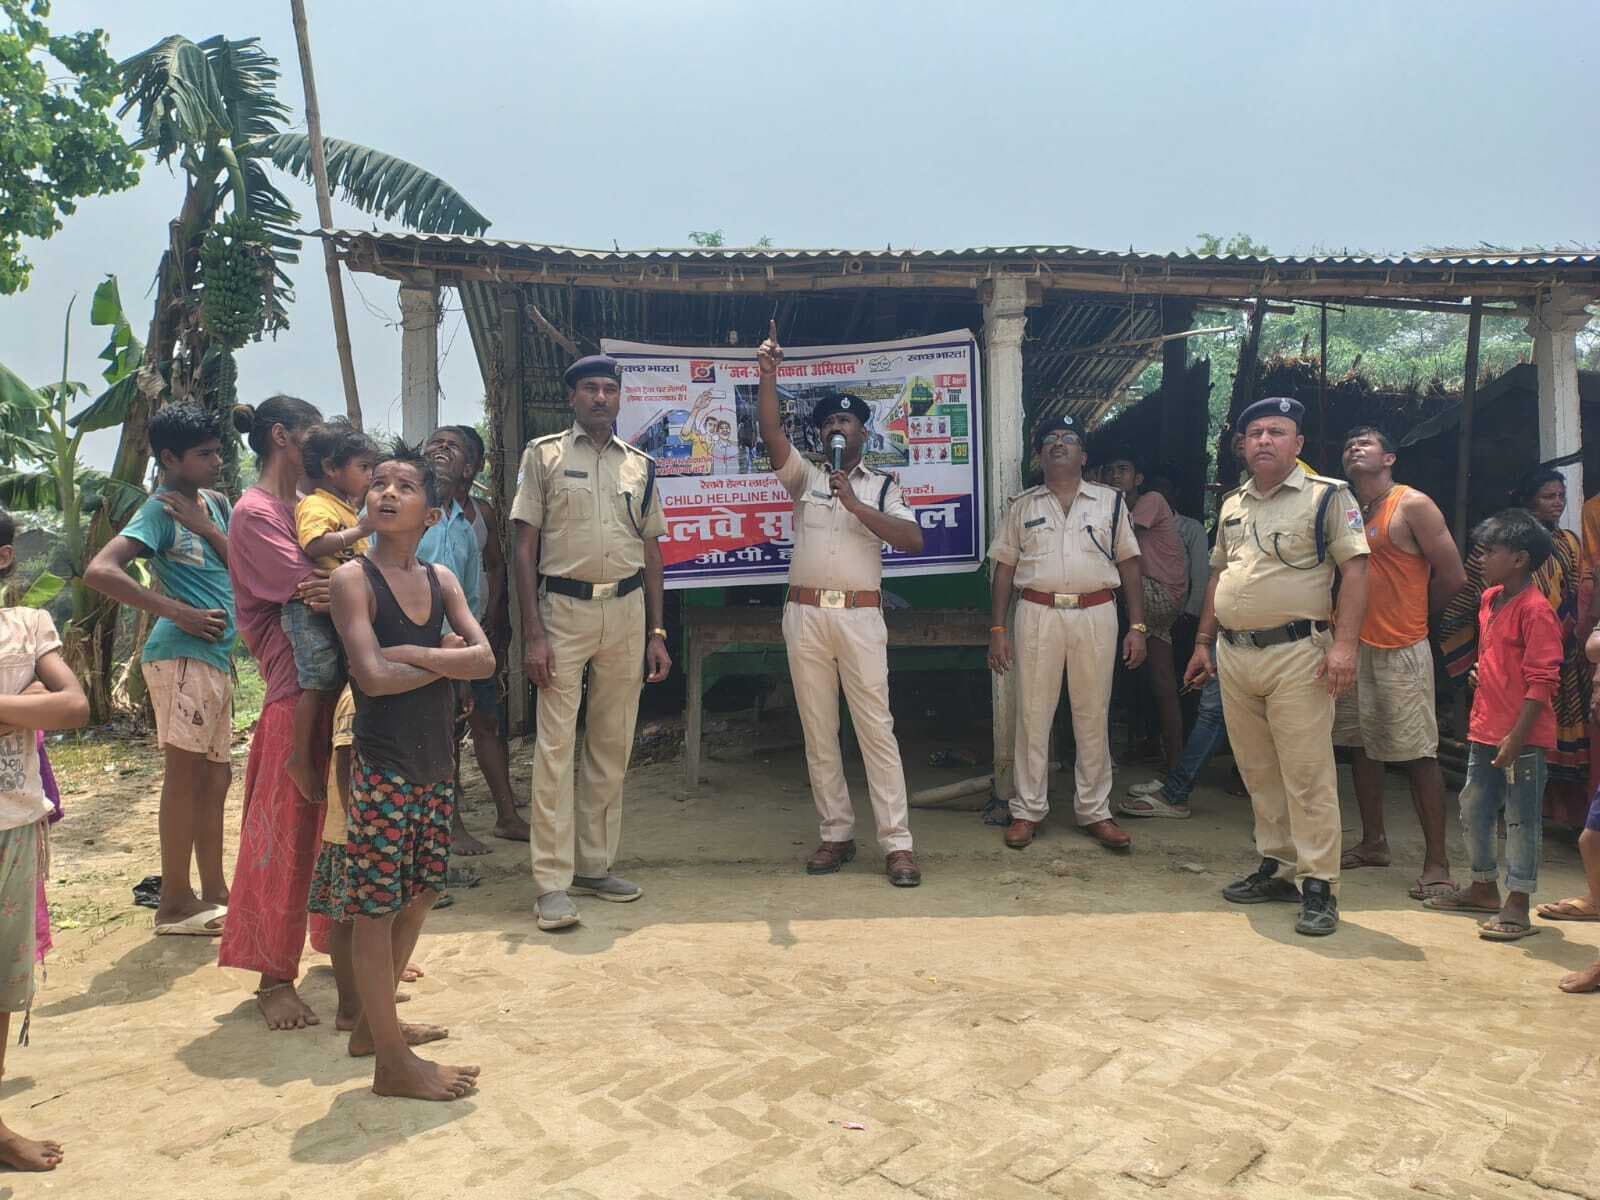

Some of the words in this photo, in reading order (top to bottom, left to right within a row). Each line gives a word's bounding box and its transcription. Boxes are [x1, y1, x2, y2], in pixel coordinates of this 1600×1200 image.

[665, 495, 703, 507] CHILD
[706, 491, 769, 505] HELPLINE
[772, 490, 793, 502] NU
